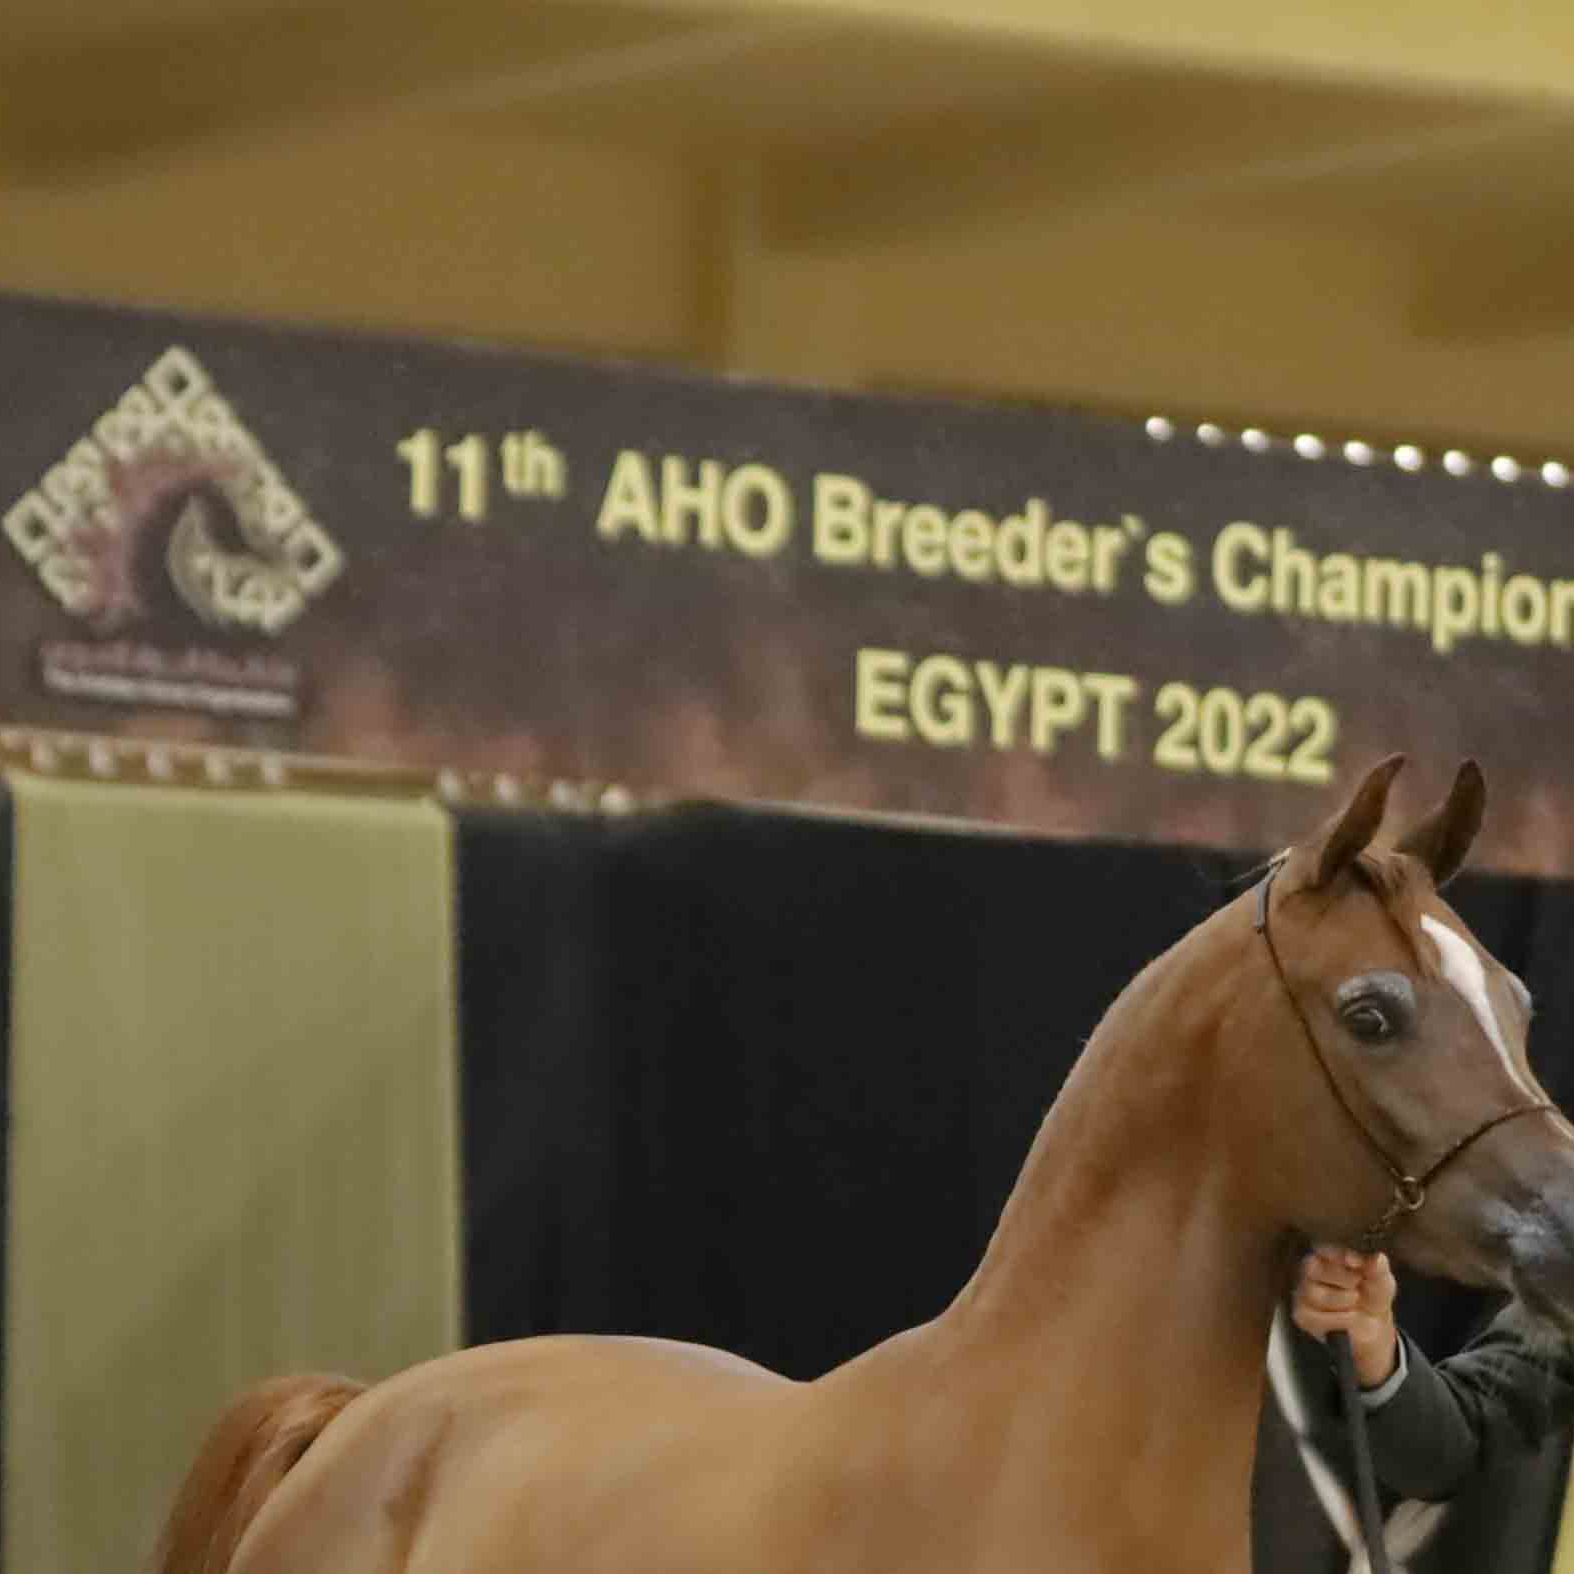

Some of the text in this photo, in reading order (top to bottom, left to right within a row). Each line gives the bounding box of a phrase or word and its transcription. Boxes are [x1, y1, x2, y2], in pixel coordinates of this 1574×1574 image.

[395, 426, 567, 523] 11th
[594, 449, 795, 560] AHO
[853, 646, 1337, 786] EGYPT 2022
